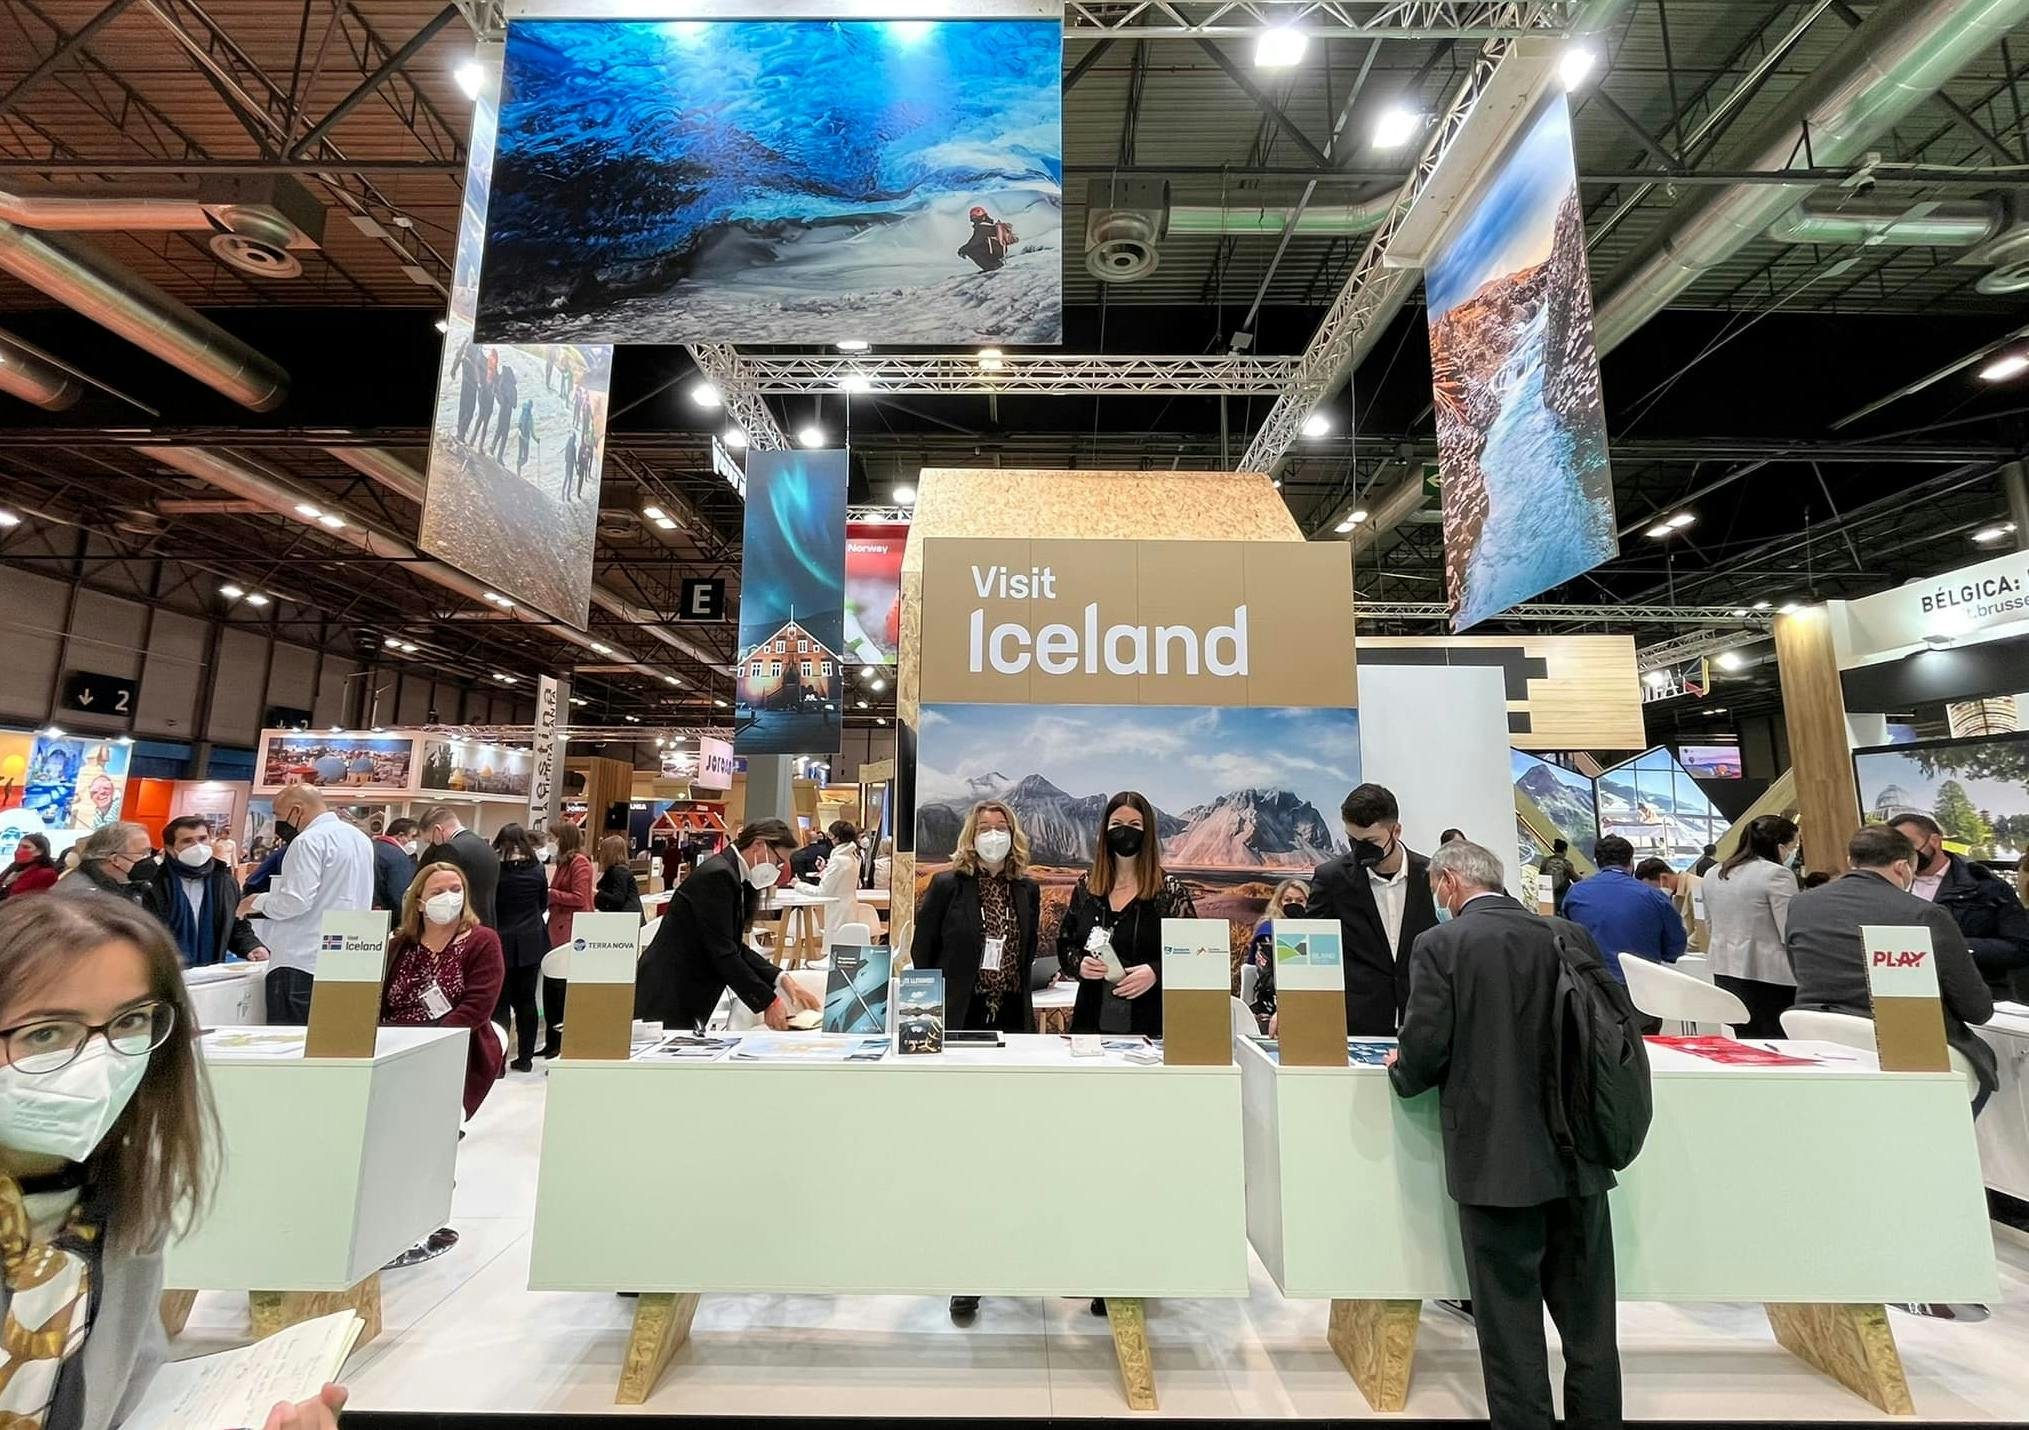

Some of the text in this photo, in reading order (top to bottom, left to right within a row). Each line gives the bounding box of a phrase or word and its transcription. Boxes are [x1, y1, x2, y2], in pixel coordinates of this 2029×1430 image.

[847, 543, 888, 554] Norway
[971, 565, 1056, 599] Visit
[1921, 576, 2020, 613] BÉLGICA:
[692, 584, 712, 614] E
[969, 602, 1249, 676] Iceland
[115, 690, 130, 712] 2
[345, 940, 383, 952] Iceland
[1873, 951, 1928, 968] PLAY
